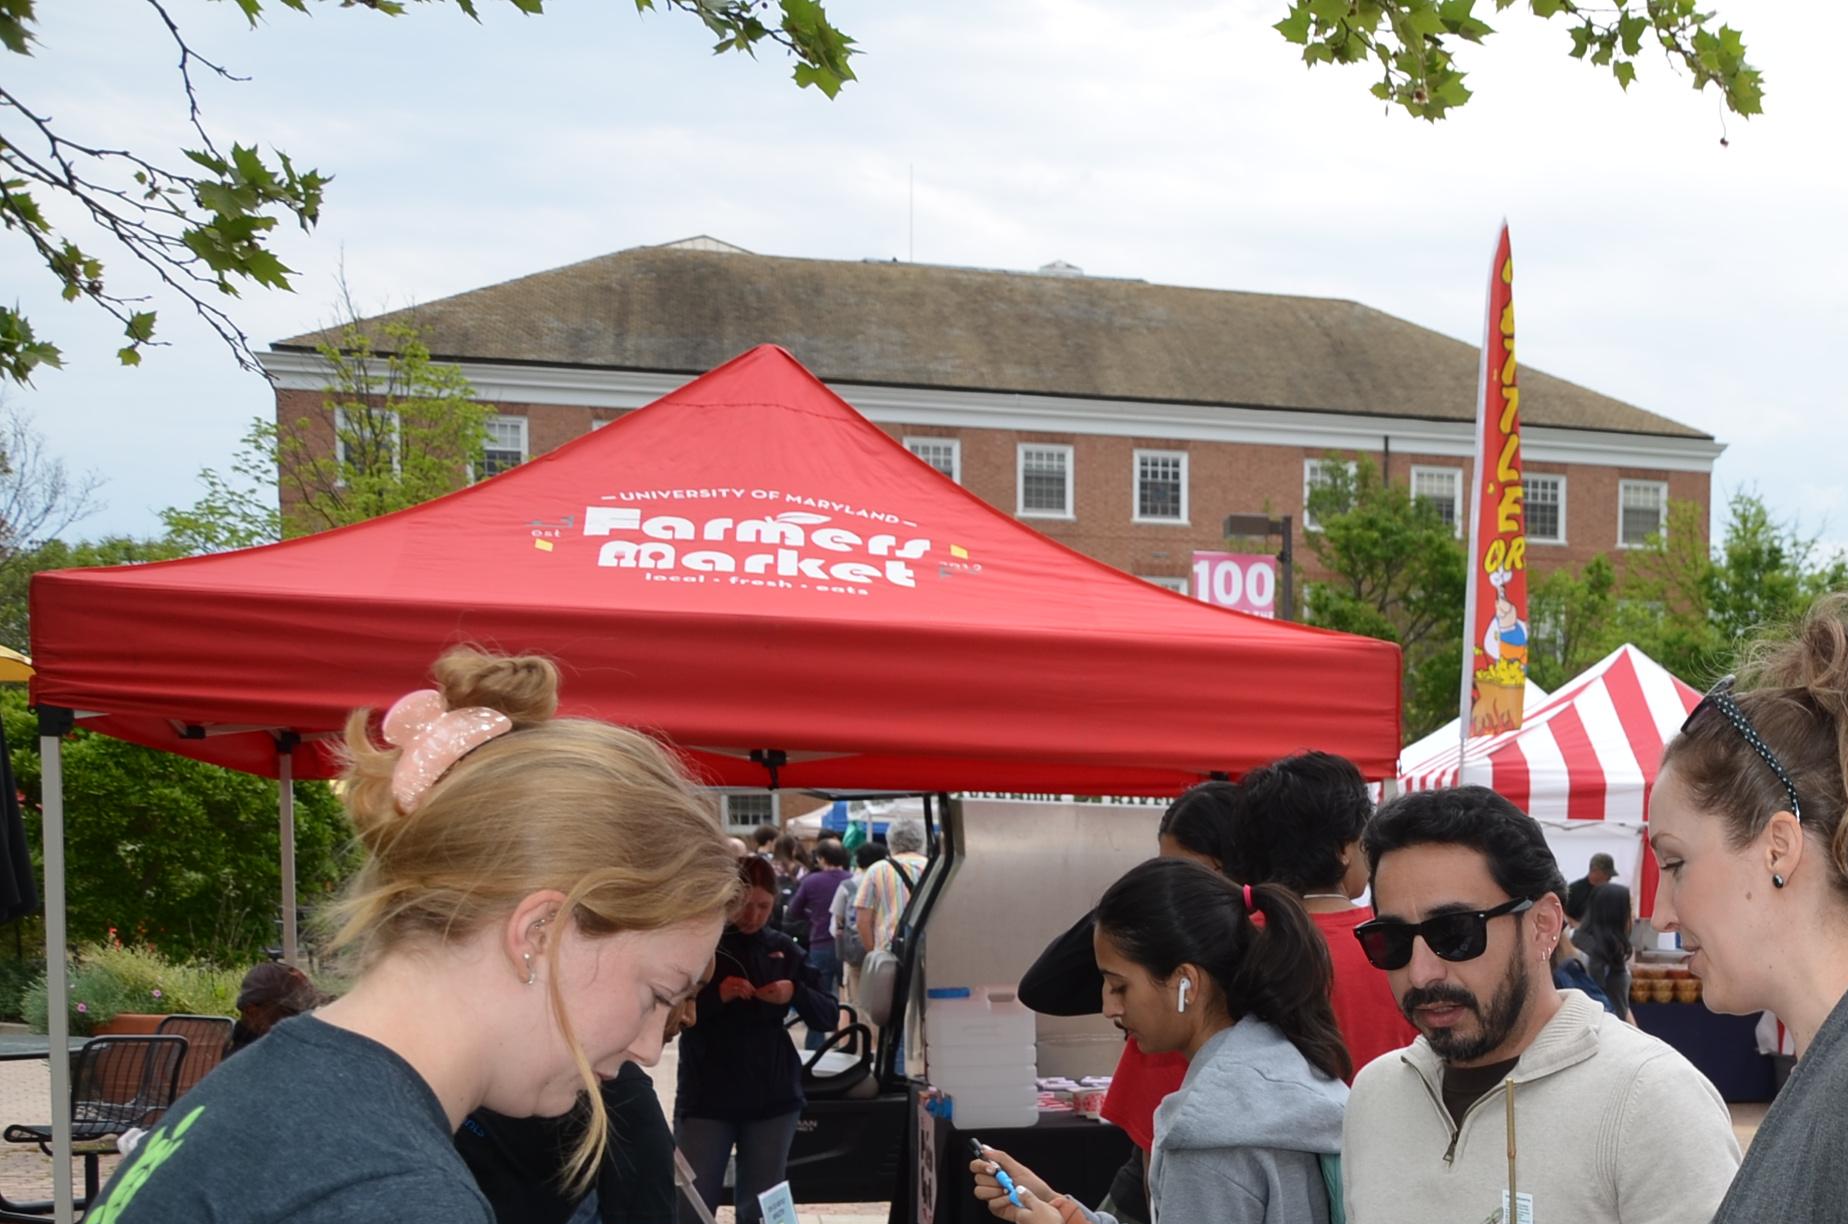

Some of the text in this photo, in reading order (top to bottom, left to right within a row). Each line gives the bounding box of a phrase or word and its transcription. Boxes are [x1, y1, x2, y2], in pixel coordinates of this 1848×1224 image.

[619, 488, 899, 525] UNIVERSITY OF MARYLAND
[583, 506, 931, 559] Farmers
[645, 572, 869, 595] local fresh eats
[1192, 560, 1276, 607] 100
